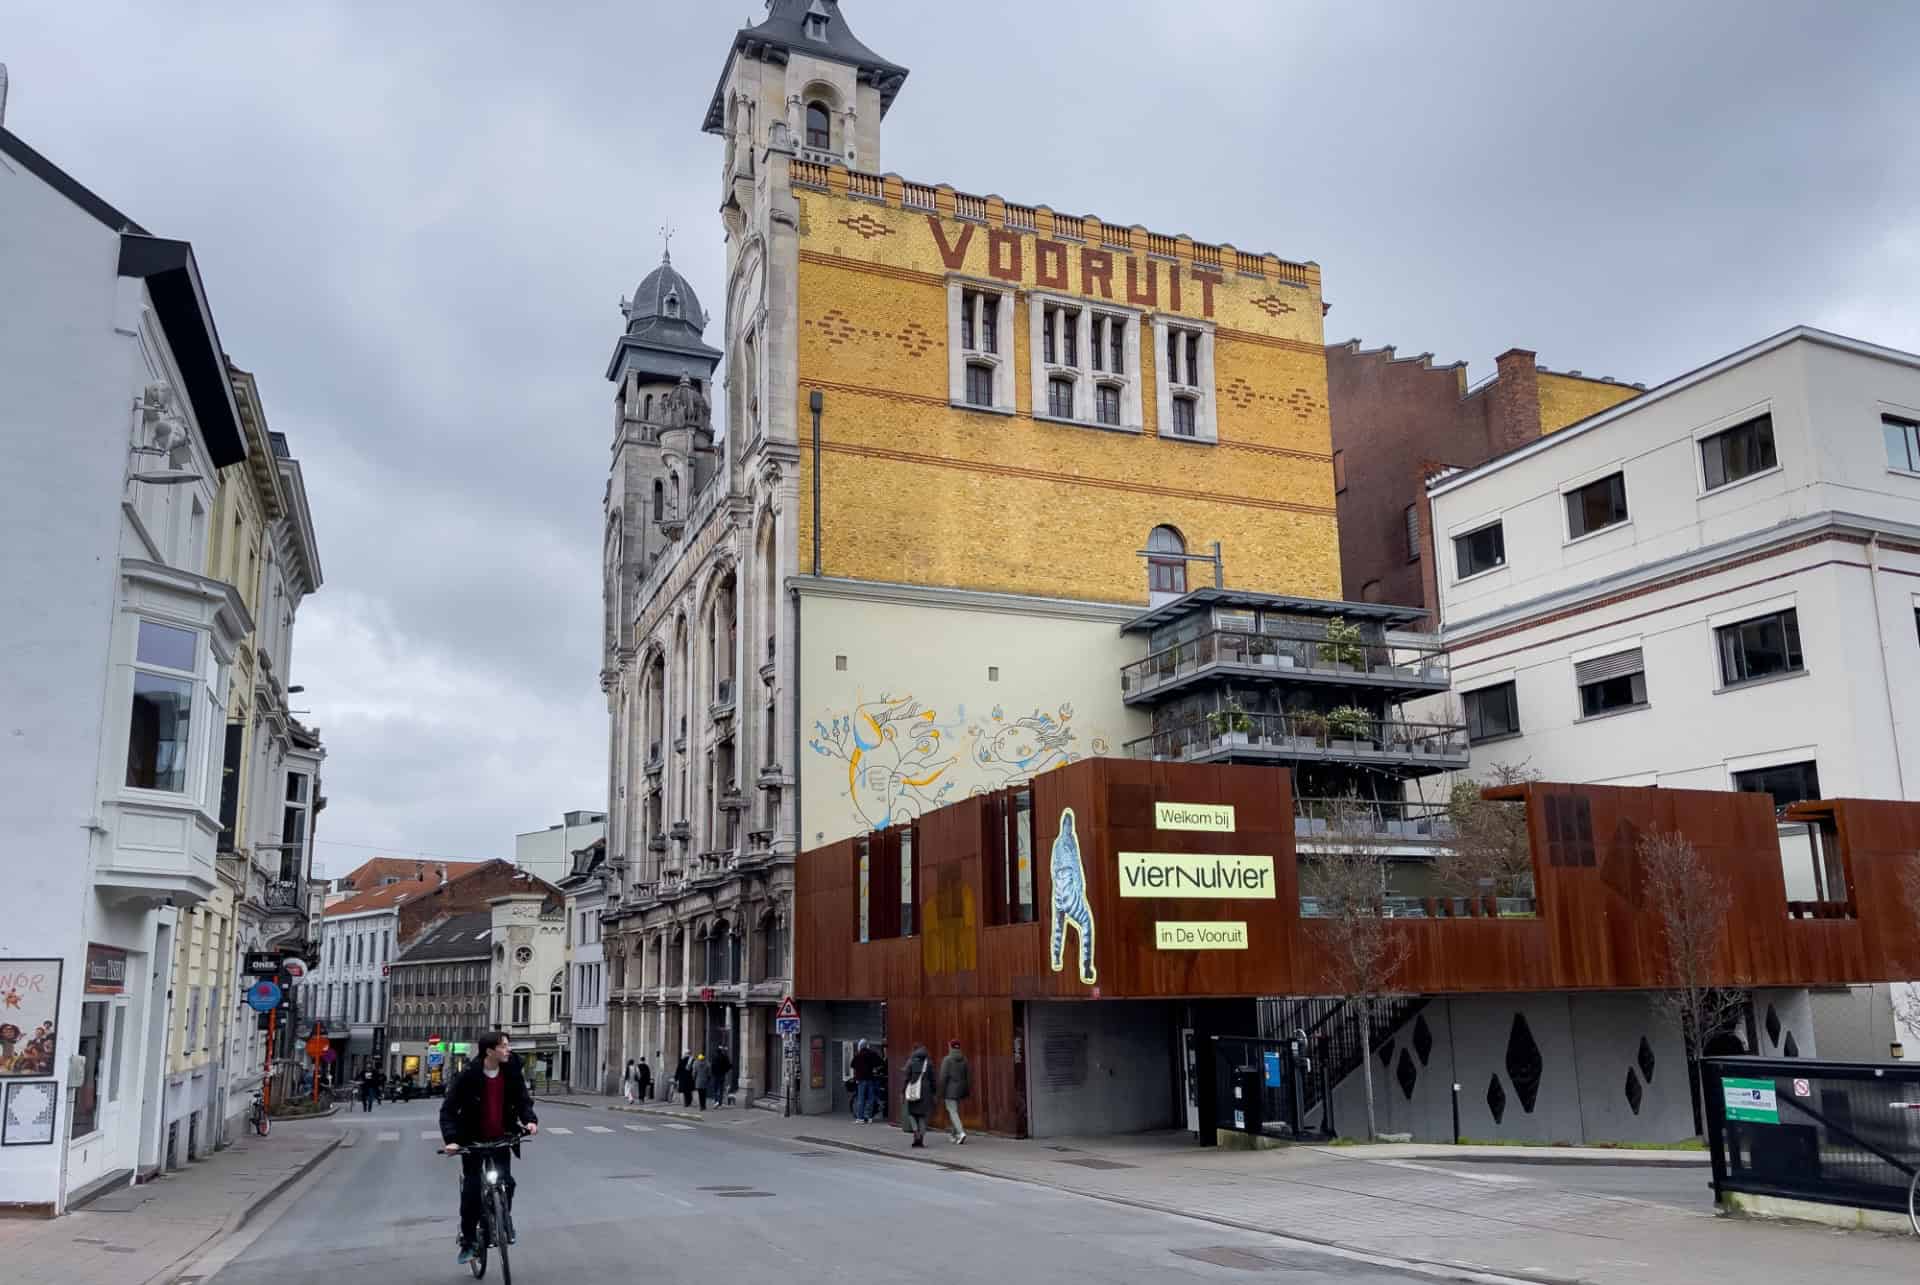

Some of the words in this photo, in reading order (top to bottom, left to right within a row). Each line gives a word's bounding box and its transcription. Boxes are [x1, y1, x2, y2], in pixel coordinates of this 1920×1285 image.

[928, 214, 1223, 318] VOORUIT
[1160, 808, 1212, 825] Welkom
[1215, 813, 1230, 829] bij
[1125, 858, 1269, 889] vierNulvier
[1161, 928, 1173, 943] in
[1176, 928, 1195, 943] De
[1197, 928, 1243, 943] Vooruit
